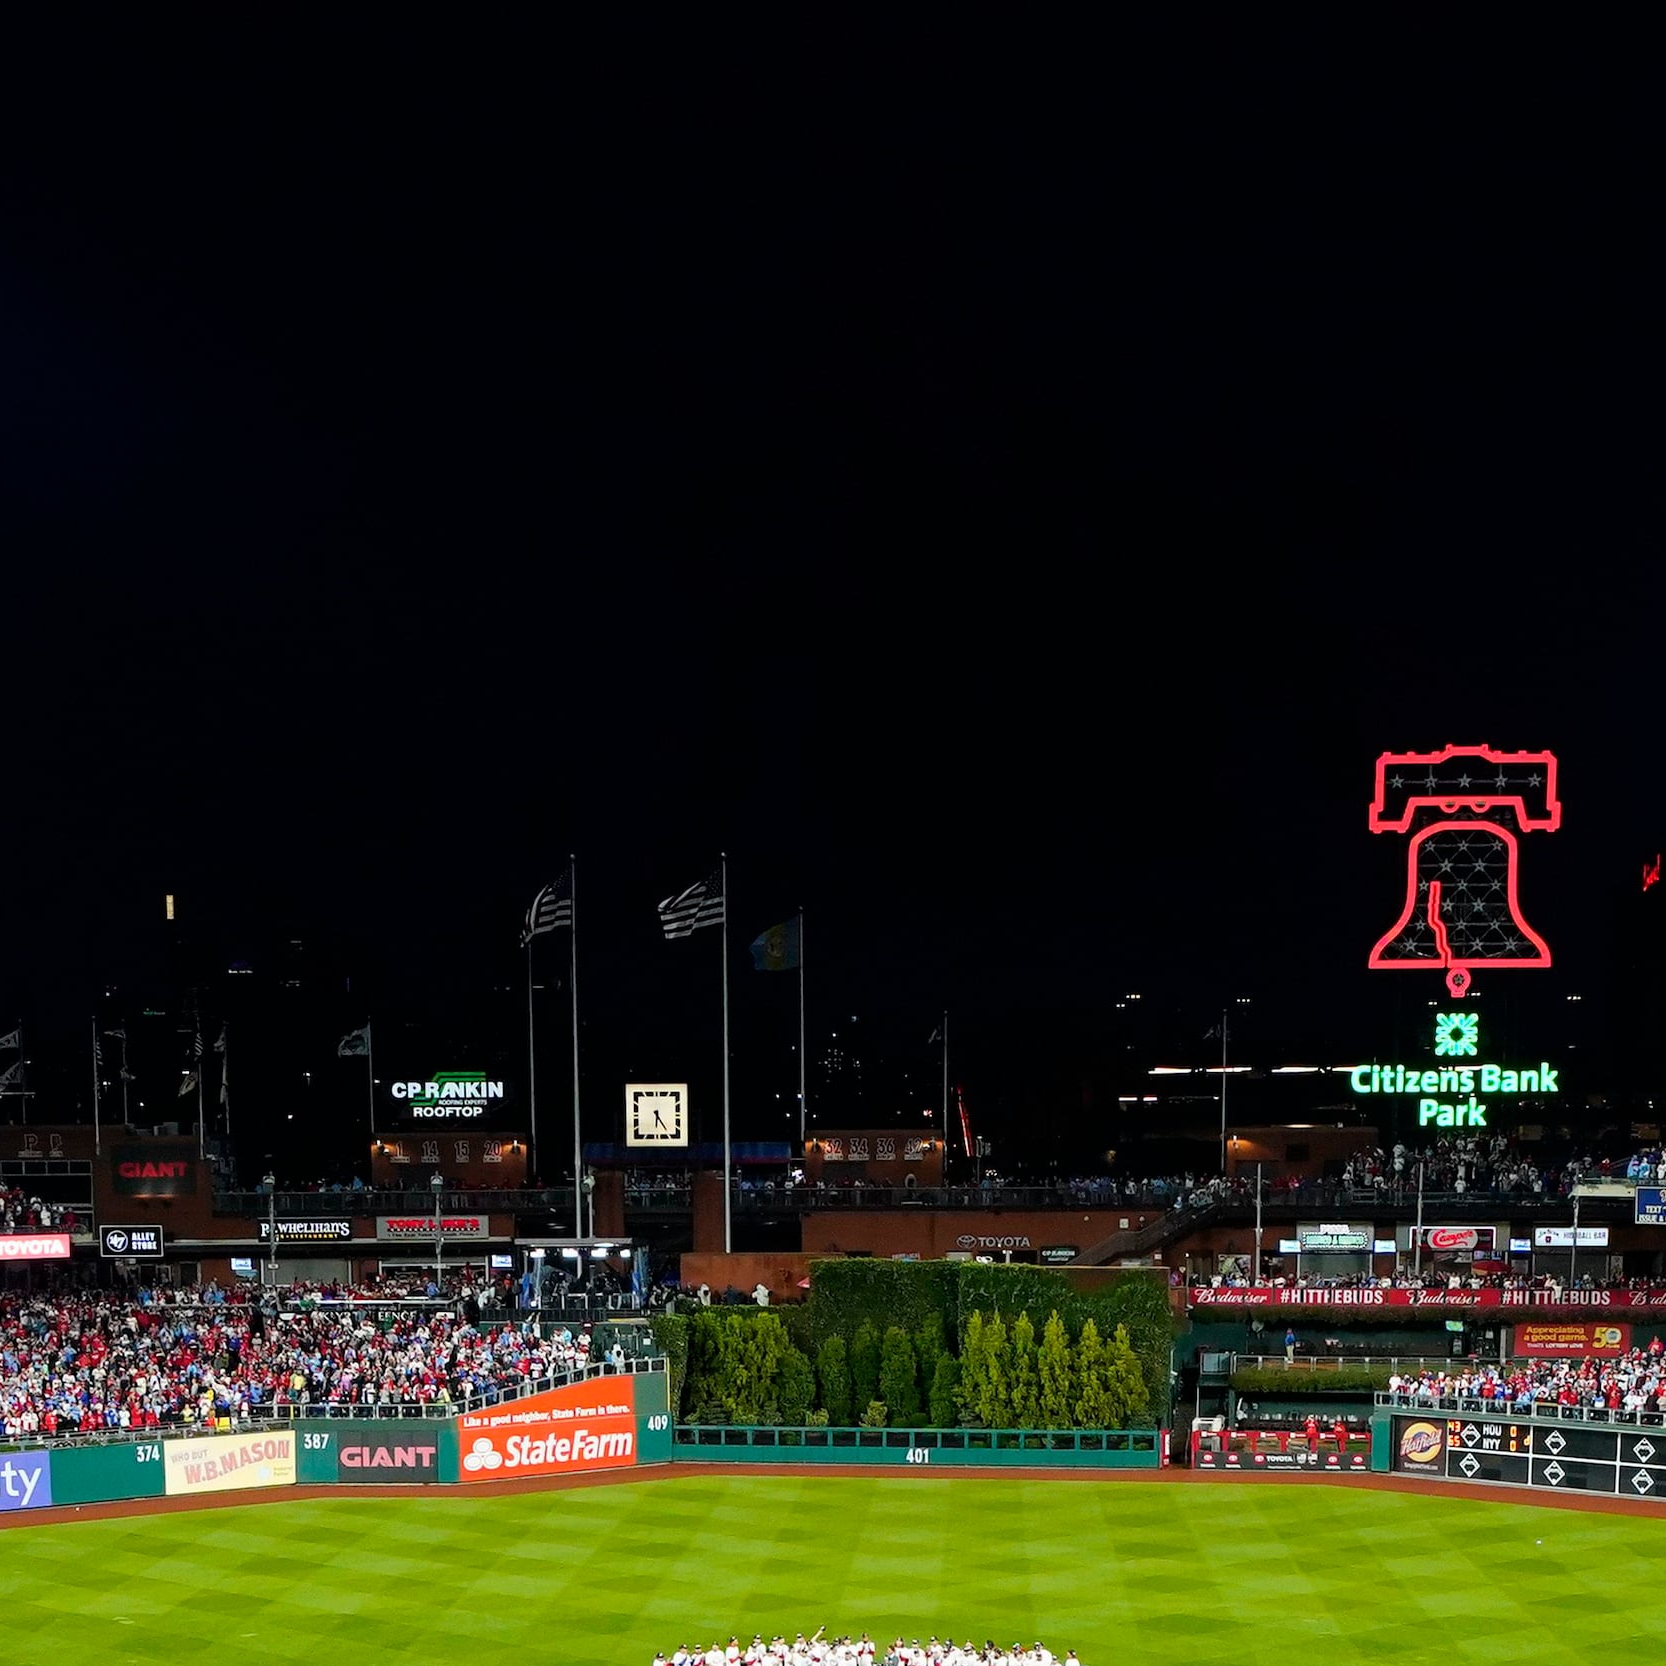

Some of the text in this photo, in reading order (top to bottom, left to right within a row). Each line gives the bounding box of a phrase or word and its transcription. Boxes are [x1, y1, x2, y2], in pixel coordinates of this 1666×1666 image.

[1350, 1062, 1559, 1095] Citizens Bank
[391, 1081, 504, 1099] CP RANKIN
[413, 1107, 483, 1118] ROOFTOP
[1419, 1098, 1488, 1128] Park
[422, 1140, 502, 1157] 14 15 20
[823, 1138, 843, 1154] 32
[848, 1138, 869, 1154] 34
[876, 1138, 896, 1154] 36
[118, 1161, 187, 1179] GIANT
[1645, 1206, 1661, 1214] TEXT
[132, 1232, 156, 1241] ALLEY
[978, 1237, 1031, 1248] TOYOTA
[132, 1242, 158, 1251] STORE
[1196, 1287, 1269, 1305] Budweiser
[1280, 1288, 1383, 1305] #HITTHEBUDS
[1406, 1288, 1482, 1306] Budweiser
[1526, 1326, 1585, 1336] Appreciating
[1531, 1334, 1556, 1342] good
[463, 1404, 630, 1427] Like good neighbor, State Farm is there.
[647, 1415, 668, 1431] 409
[1482, 1424, 1517, 1438] HOU 0
[303, 1433, 330, 1450] 387
[1400, 1428, 1442, 1457] Hatfield
[1482, 1438, 1517, 1452] NYY 0
[136, 1443, 161, 1464] 374
[170, 1449, 208, 1464] WHO BUT
[339, 1446, 436, 1468] GIANT
[905, 1447, 930, 1464] 401
[1266, 1455, 1293, 1463] TOYOTA
